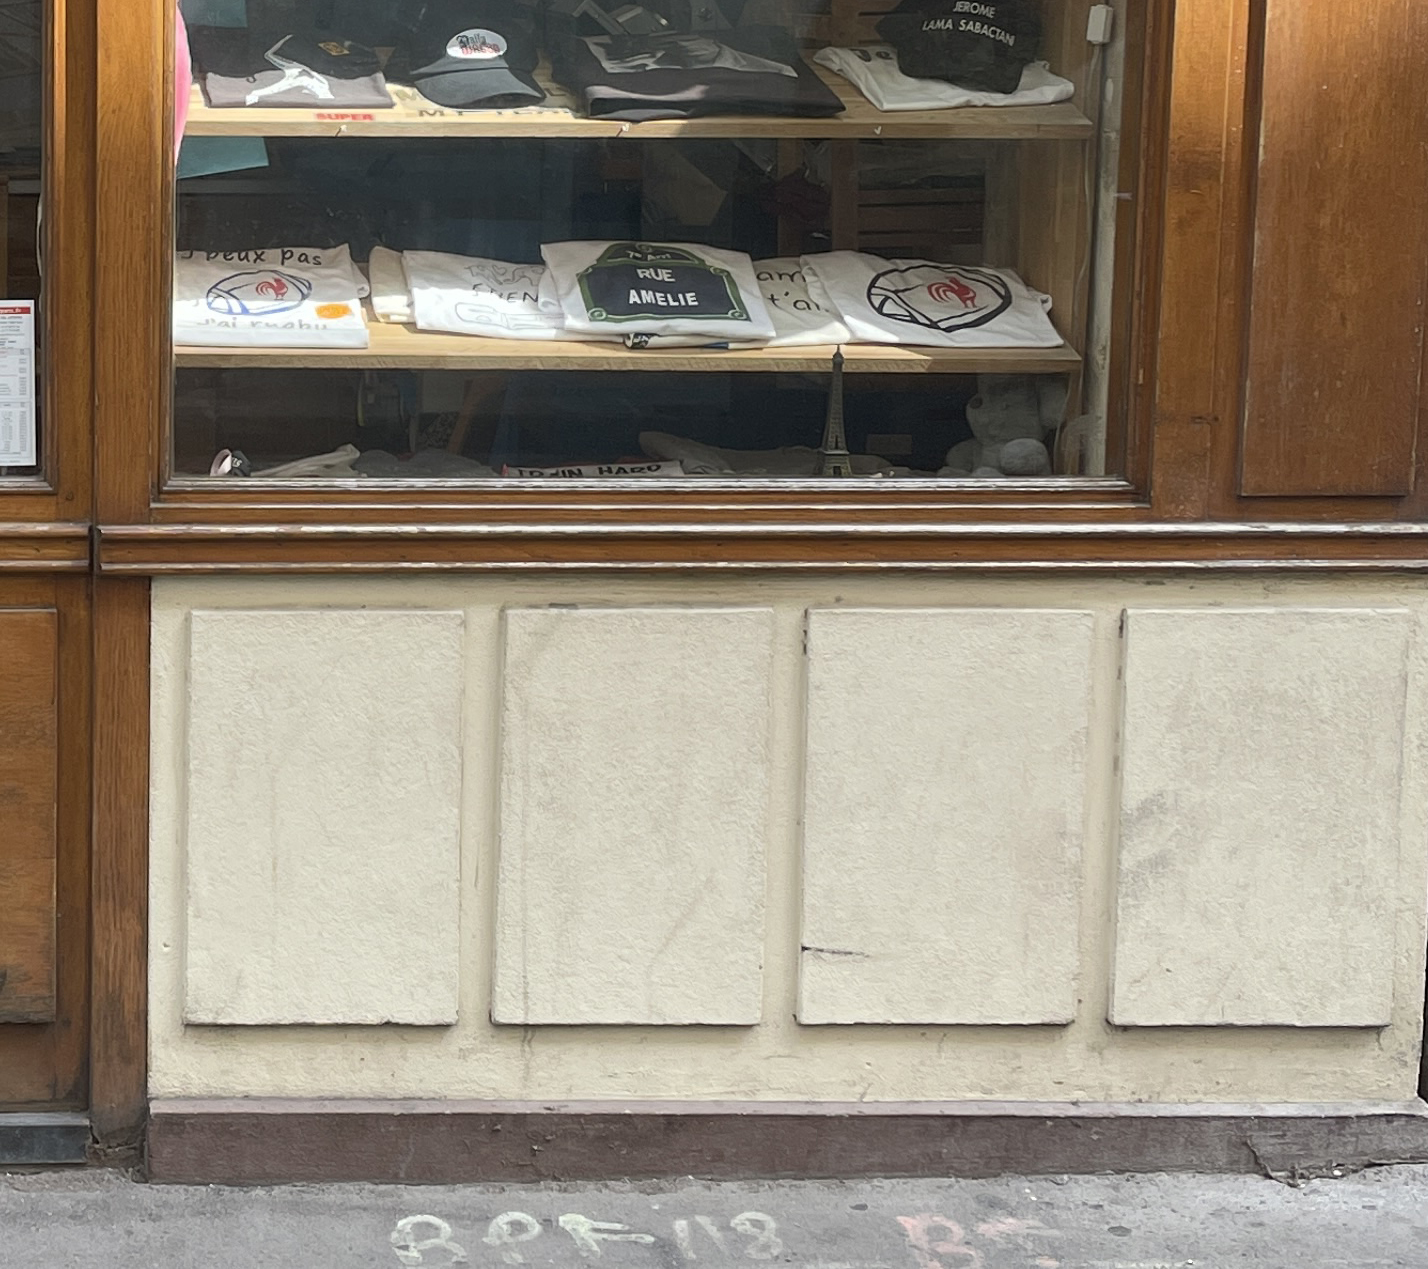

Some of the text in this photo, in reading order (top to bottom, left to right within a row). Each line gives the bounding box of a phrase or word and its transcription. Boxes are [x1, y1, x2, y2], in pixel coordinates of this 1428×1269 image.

[953, 0, 996, 18] JEROME
[922, 18, 953, 31] LAMA
[280, 248, 323, 267] pas
[636, 268, 676, 282] RUE
[628, 288, 699, 307] AMELIE
